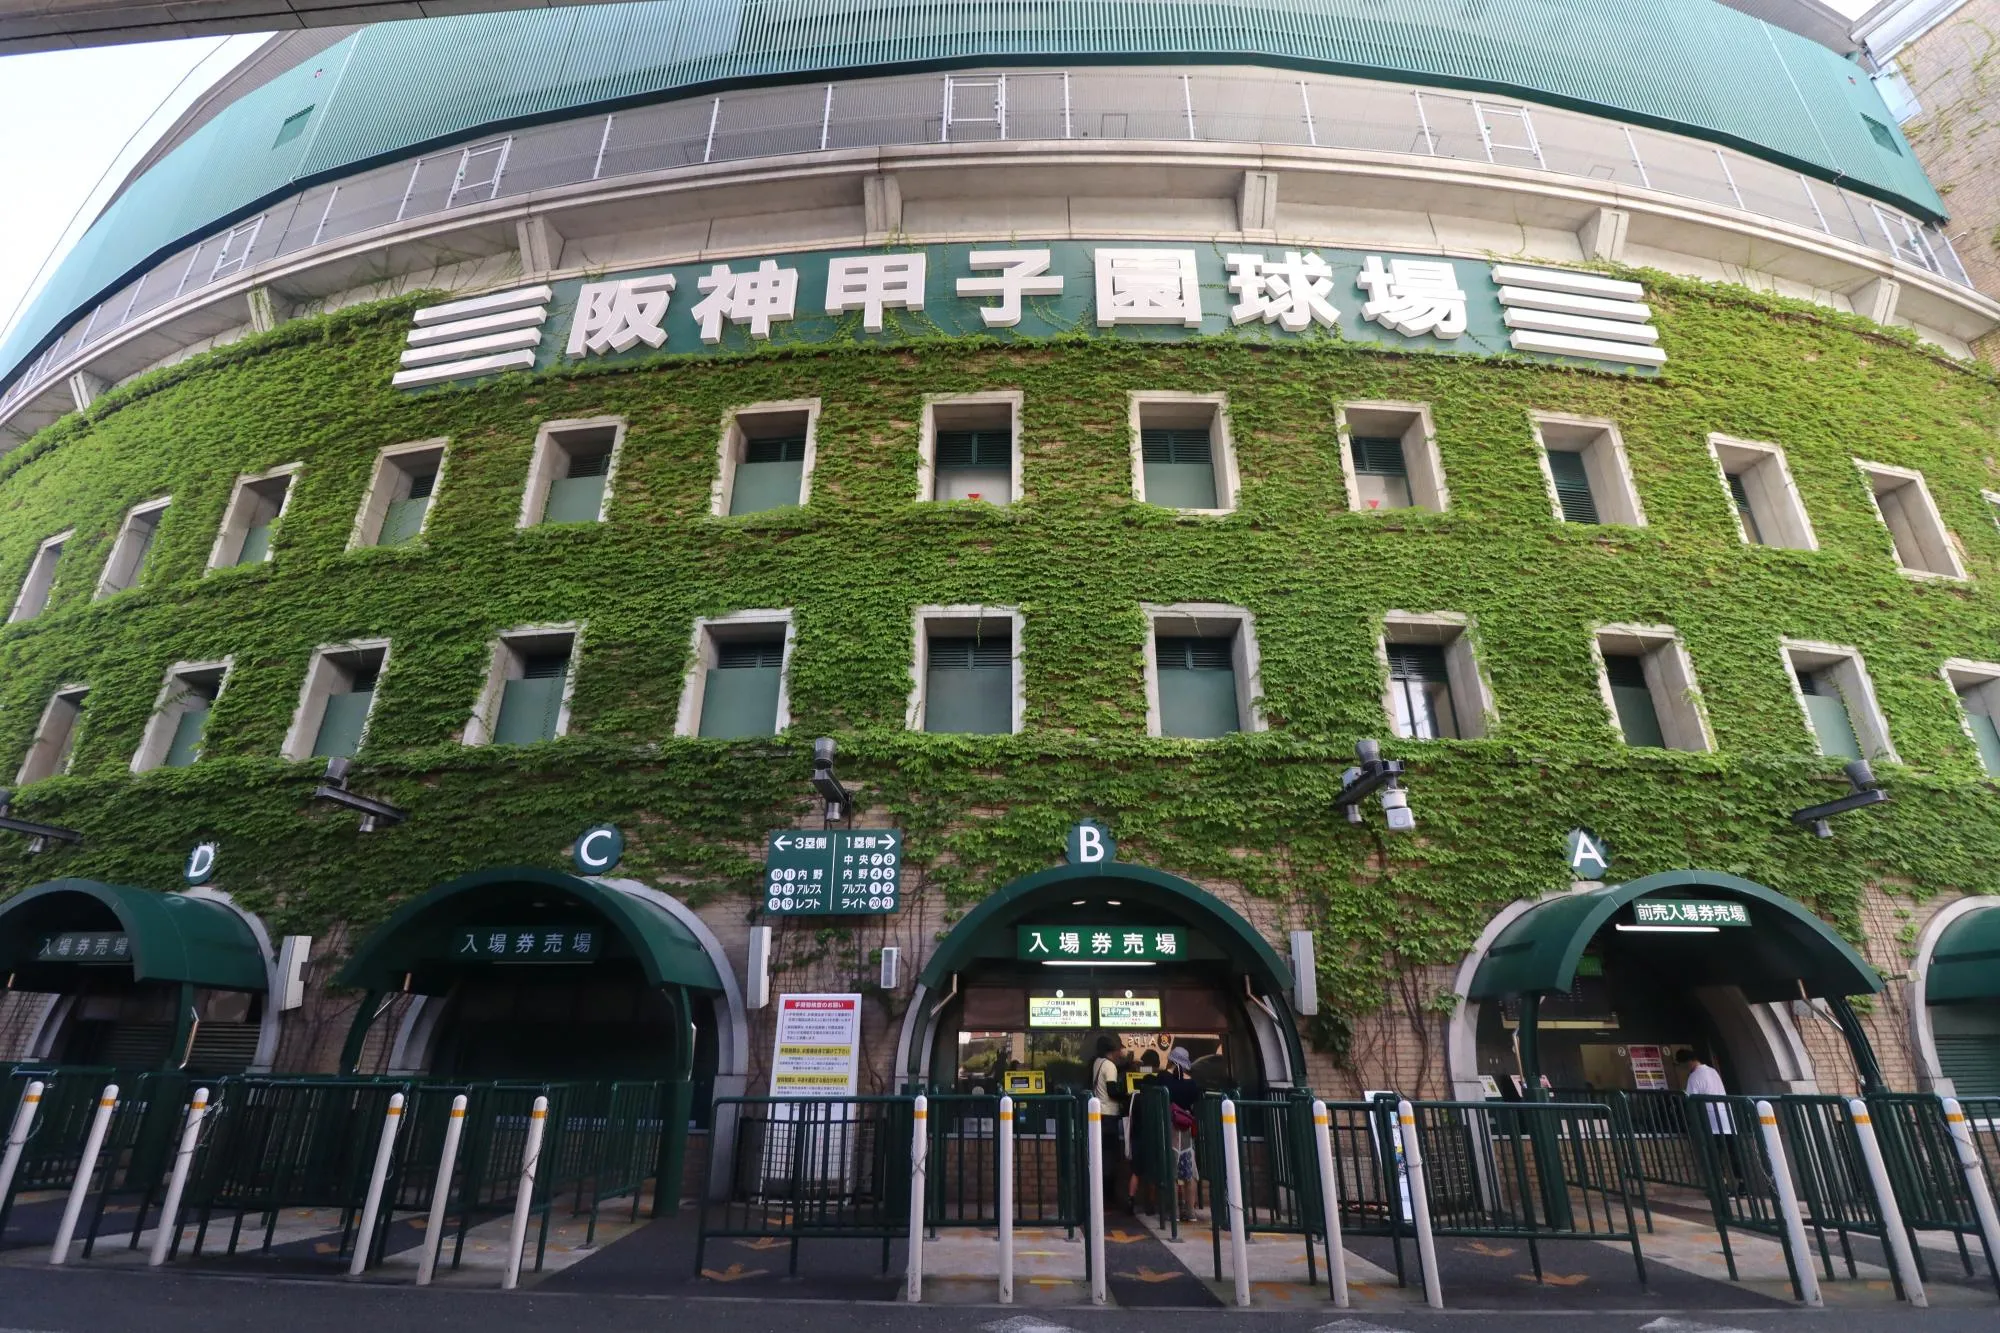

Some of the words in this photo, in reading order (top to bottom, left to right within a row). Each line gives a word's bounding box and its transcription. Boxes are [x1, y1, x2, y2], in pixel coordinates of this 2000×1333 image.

[566, 247, 1467, 359] 阪神甲子園球場
[580, 829, 612, 866] C
[794, 836, 827, 849] 3塁側
[845, 836, 876, 849] 1塁側
[1079, 825, 1105, 863] B
[1572, 830, 1608, 868] A
[188, 844, 216, 878] D
[796, 884, 822, 894] アルプス
[841, 883, 867, 894] アルプス
[796, 898, 821, 909] レフト
[841, 898, 867, 909] ライト
[1636, 903, 1747, 922] 前売入場券売場
[39, 937, 129, 957] 入場券売場
[460, 932, 592, 954] 入場券売場
[1028, 932, 1177, 955] 入場券売場
